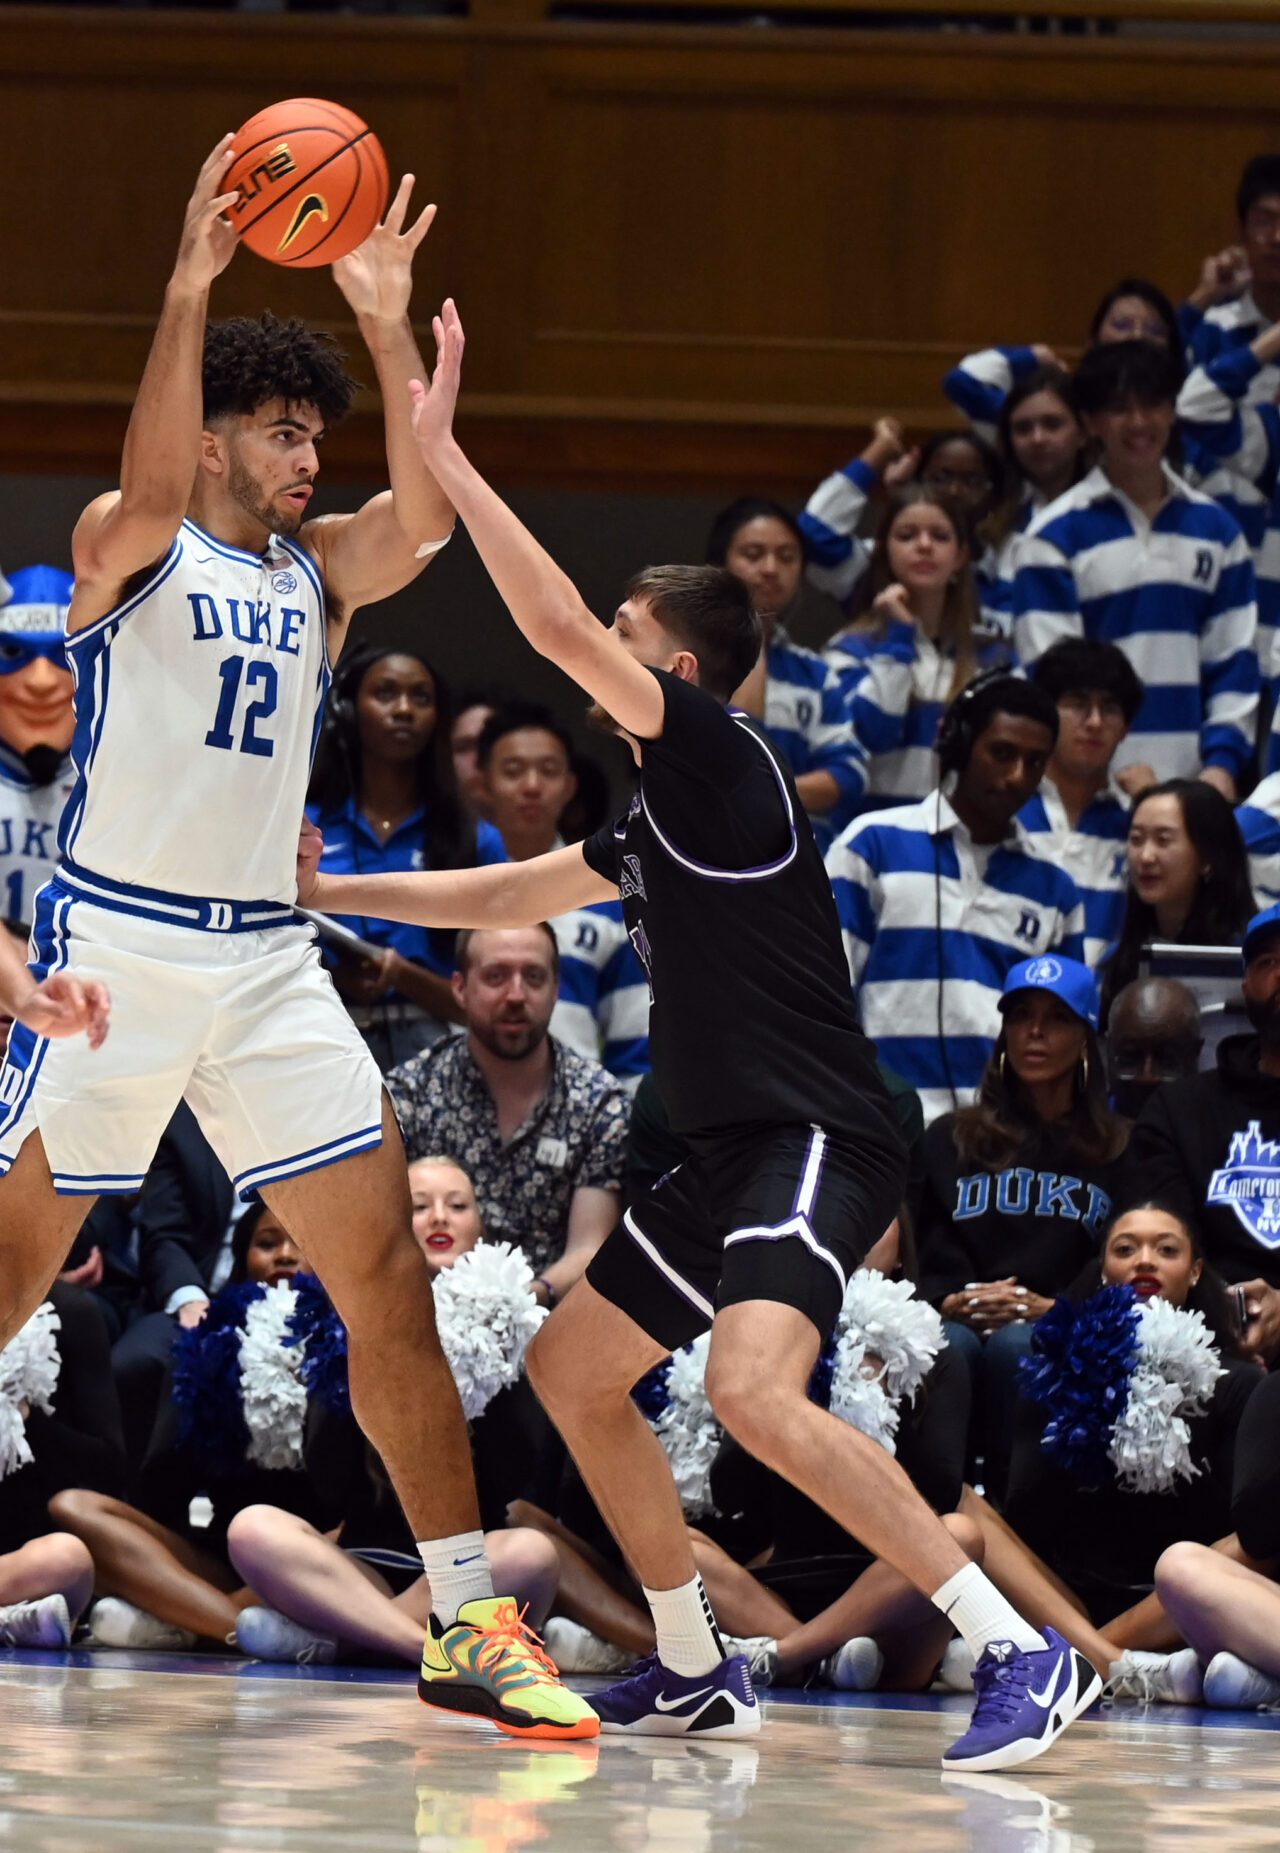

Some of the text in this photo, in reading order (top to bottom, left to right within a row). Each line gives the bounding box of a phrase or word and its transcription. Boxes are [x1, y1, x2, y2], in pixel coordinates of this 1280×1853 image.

[187, 593, 306, 656] DUKE
[205, 655, 278, 757] 12
[952, 1167, 1117, 1240] DUKE
